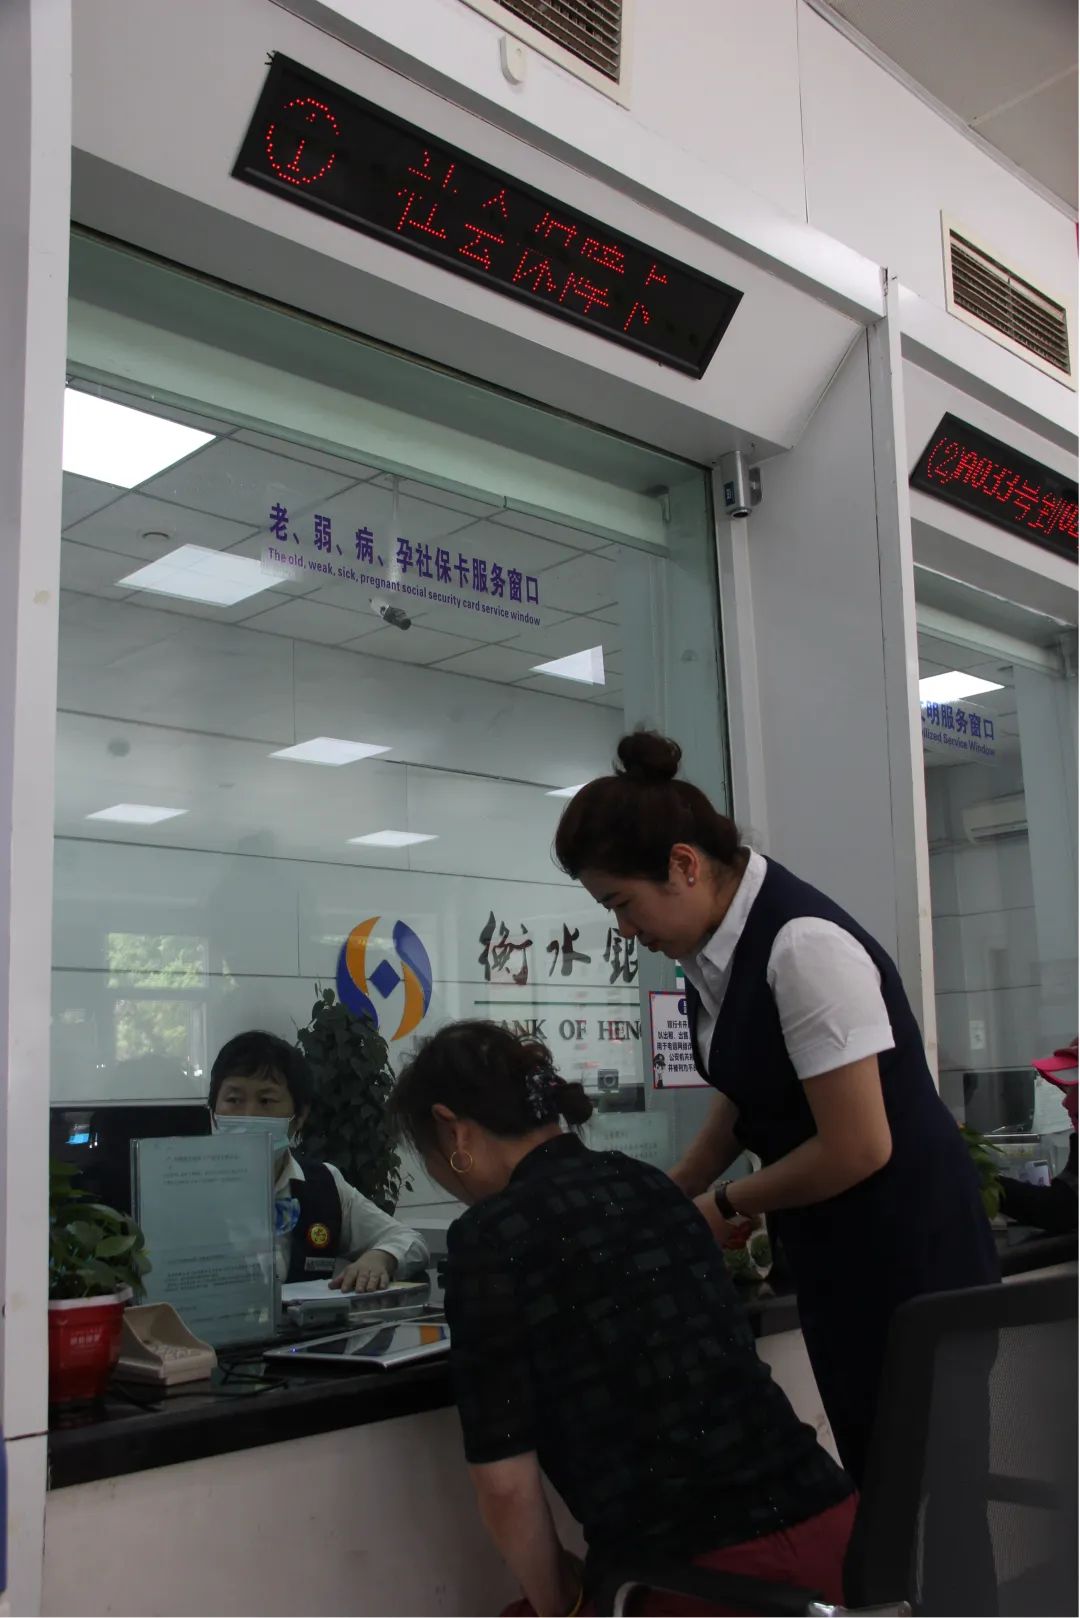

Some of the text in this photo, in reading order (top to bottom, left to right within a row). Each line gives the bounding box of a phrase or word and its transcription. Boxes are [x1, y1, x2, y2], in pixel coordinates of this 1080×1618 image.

[268, 547, 541, 626] The old, weak, sick, pregnant social security card service window
[921, 700, 995, 740] 明服务窗口
[943, 733, 968, 750] Service
[968, 740, 995, 756] Window
[558, 1019, 587, 1041] OF
[598, 1019, 643, 1041] HEN
